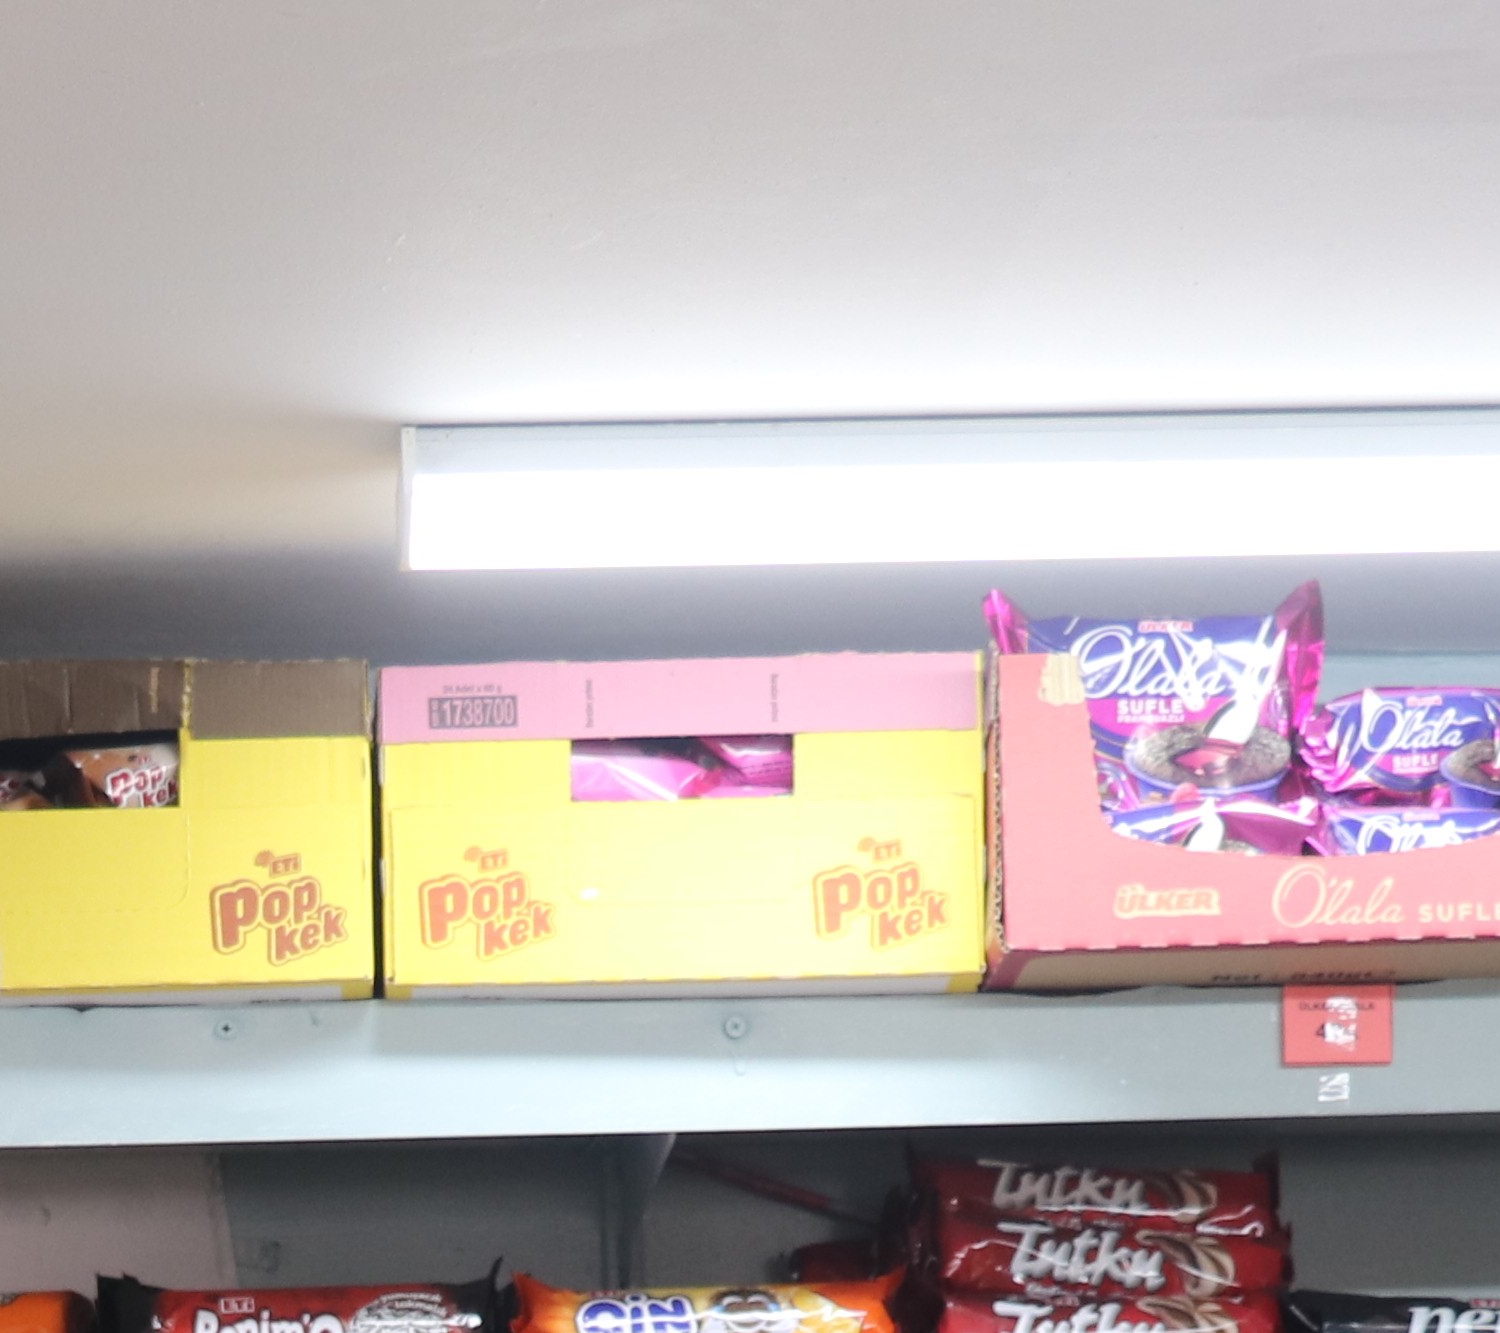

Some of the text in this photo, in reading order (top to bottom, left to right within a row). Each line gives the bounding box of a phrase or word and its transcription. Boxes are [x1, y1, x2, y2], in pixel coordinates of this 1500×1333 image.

[1118, 701, 1184, 715] SUFLE
[275, 912, 344, 962] kek
[483, 907, 552, 956] kek
[877, 896, 946, 946] kek
[998, 1222, 1165, 1289] Tutku
